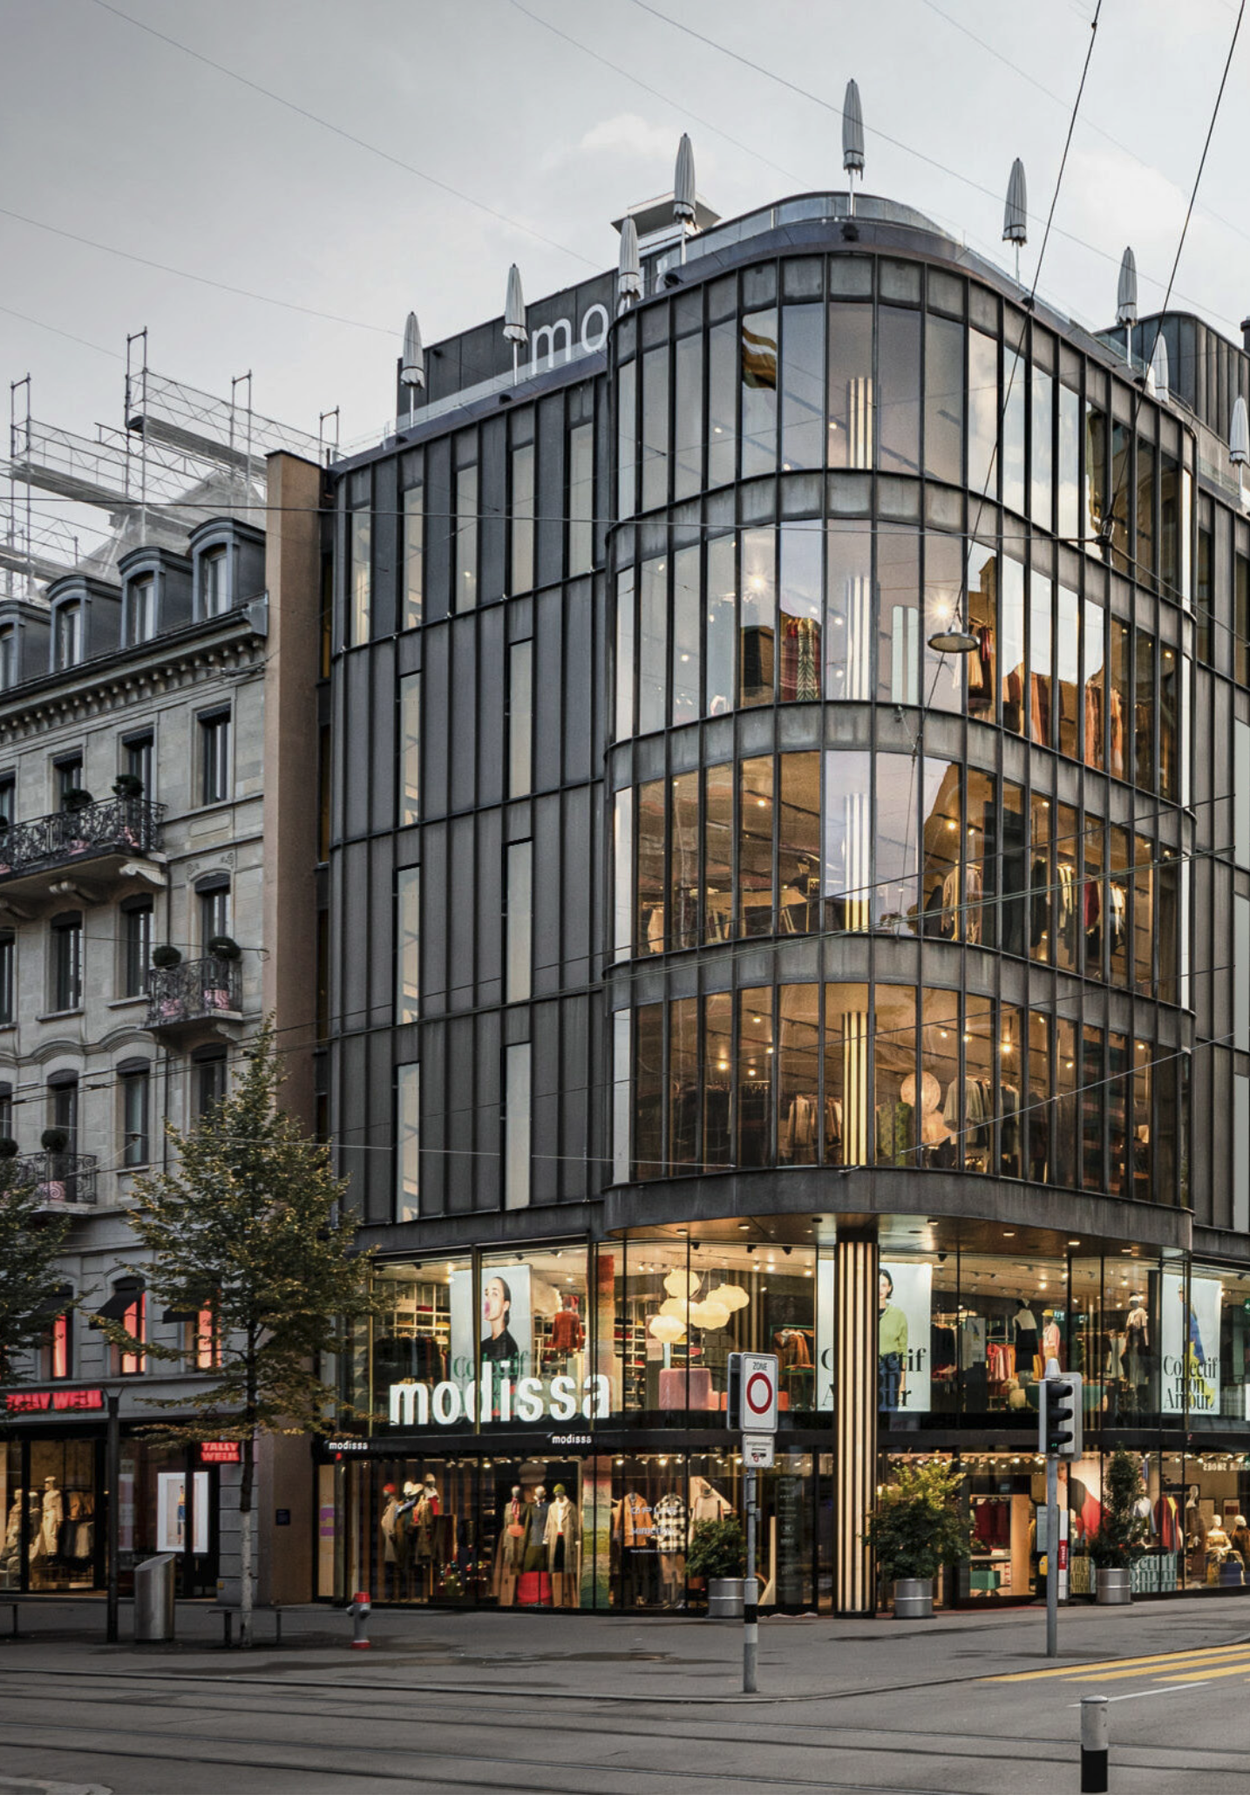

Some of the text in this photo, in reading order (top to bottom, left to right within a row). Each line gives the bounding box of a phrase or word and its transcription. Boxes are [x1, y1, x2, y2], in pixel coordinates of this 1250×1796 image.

[752, 1361, 768, 1371] ZONE
[1163, 1354, 1218, 1379] Coectif
[389, 1360, 610, 1426] modissa
[551, 1433, 592, 1444] modissa
[201, 1442, 239, 1451] TALLY
[328, 1440, 369, 1450] modissa
